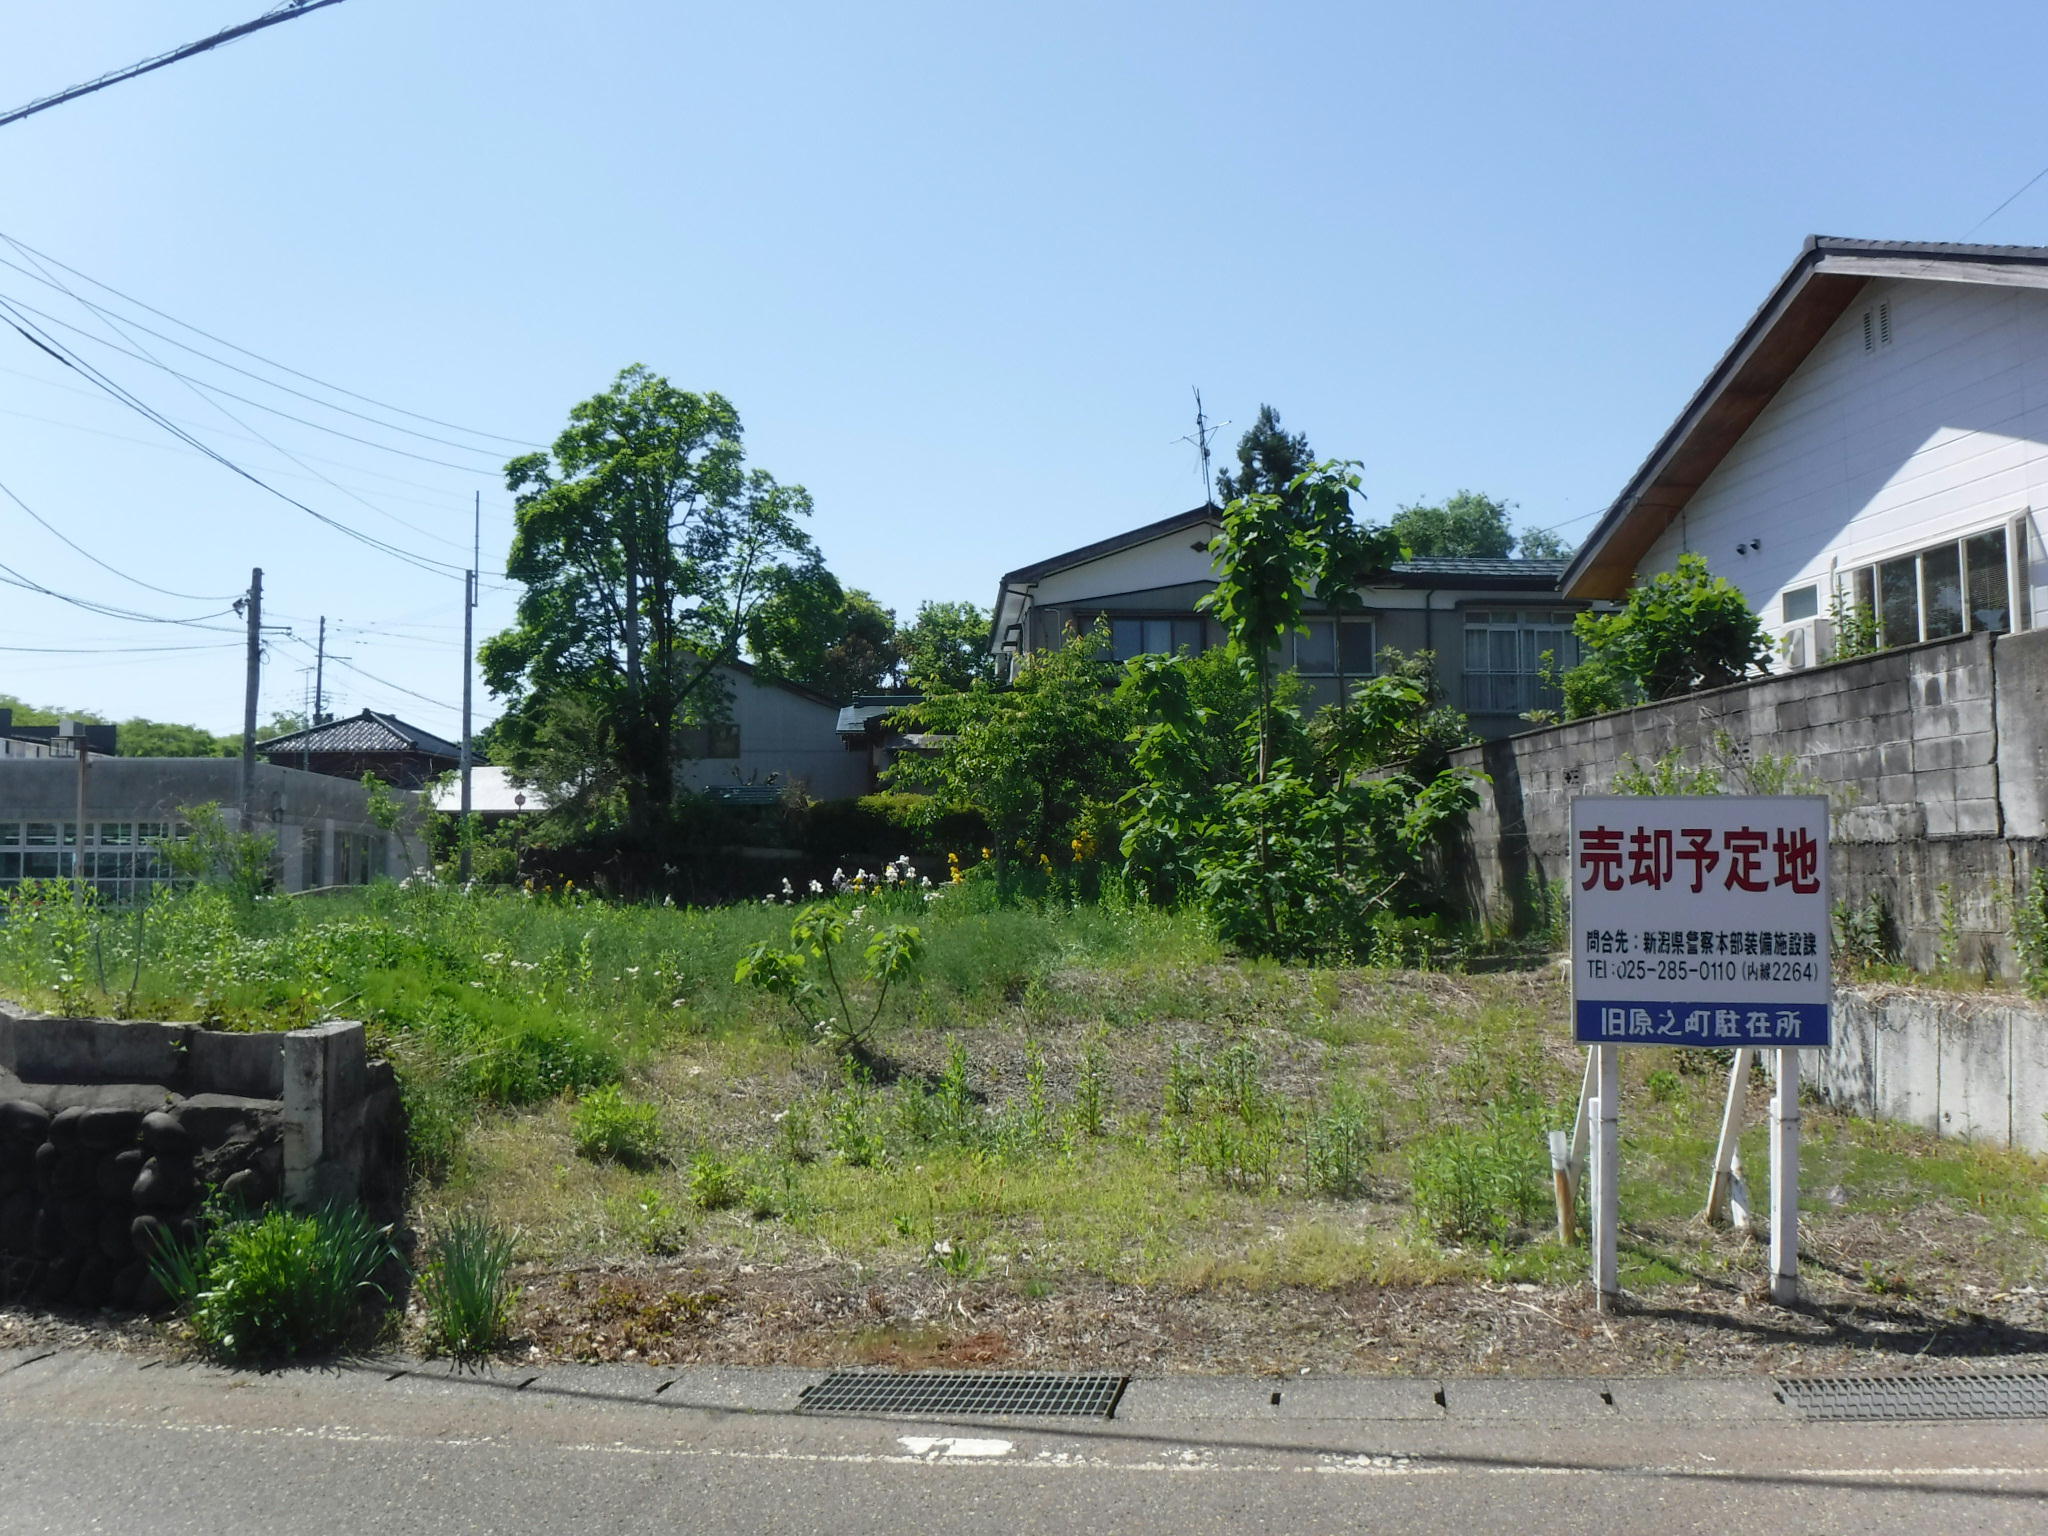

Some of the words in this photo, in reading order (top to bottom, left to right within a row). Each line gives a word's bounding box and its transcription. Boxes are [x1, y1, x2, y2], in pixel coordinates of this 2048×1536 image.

[1579, 825, 1821, 894] 売却予定地
[1601, 1007, 1802, 1038] 旧原之町駐在所
